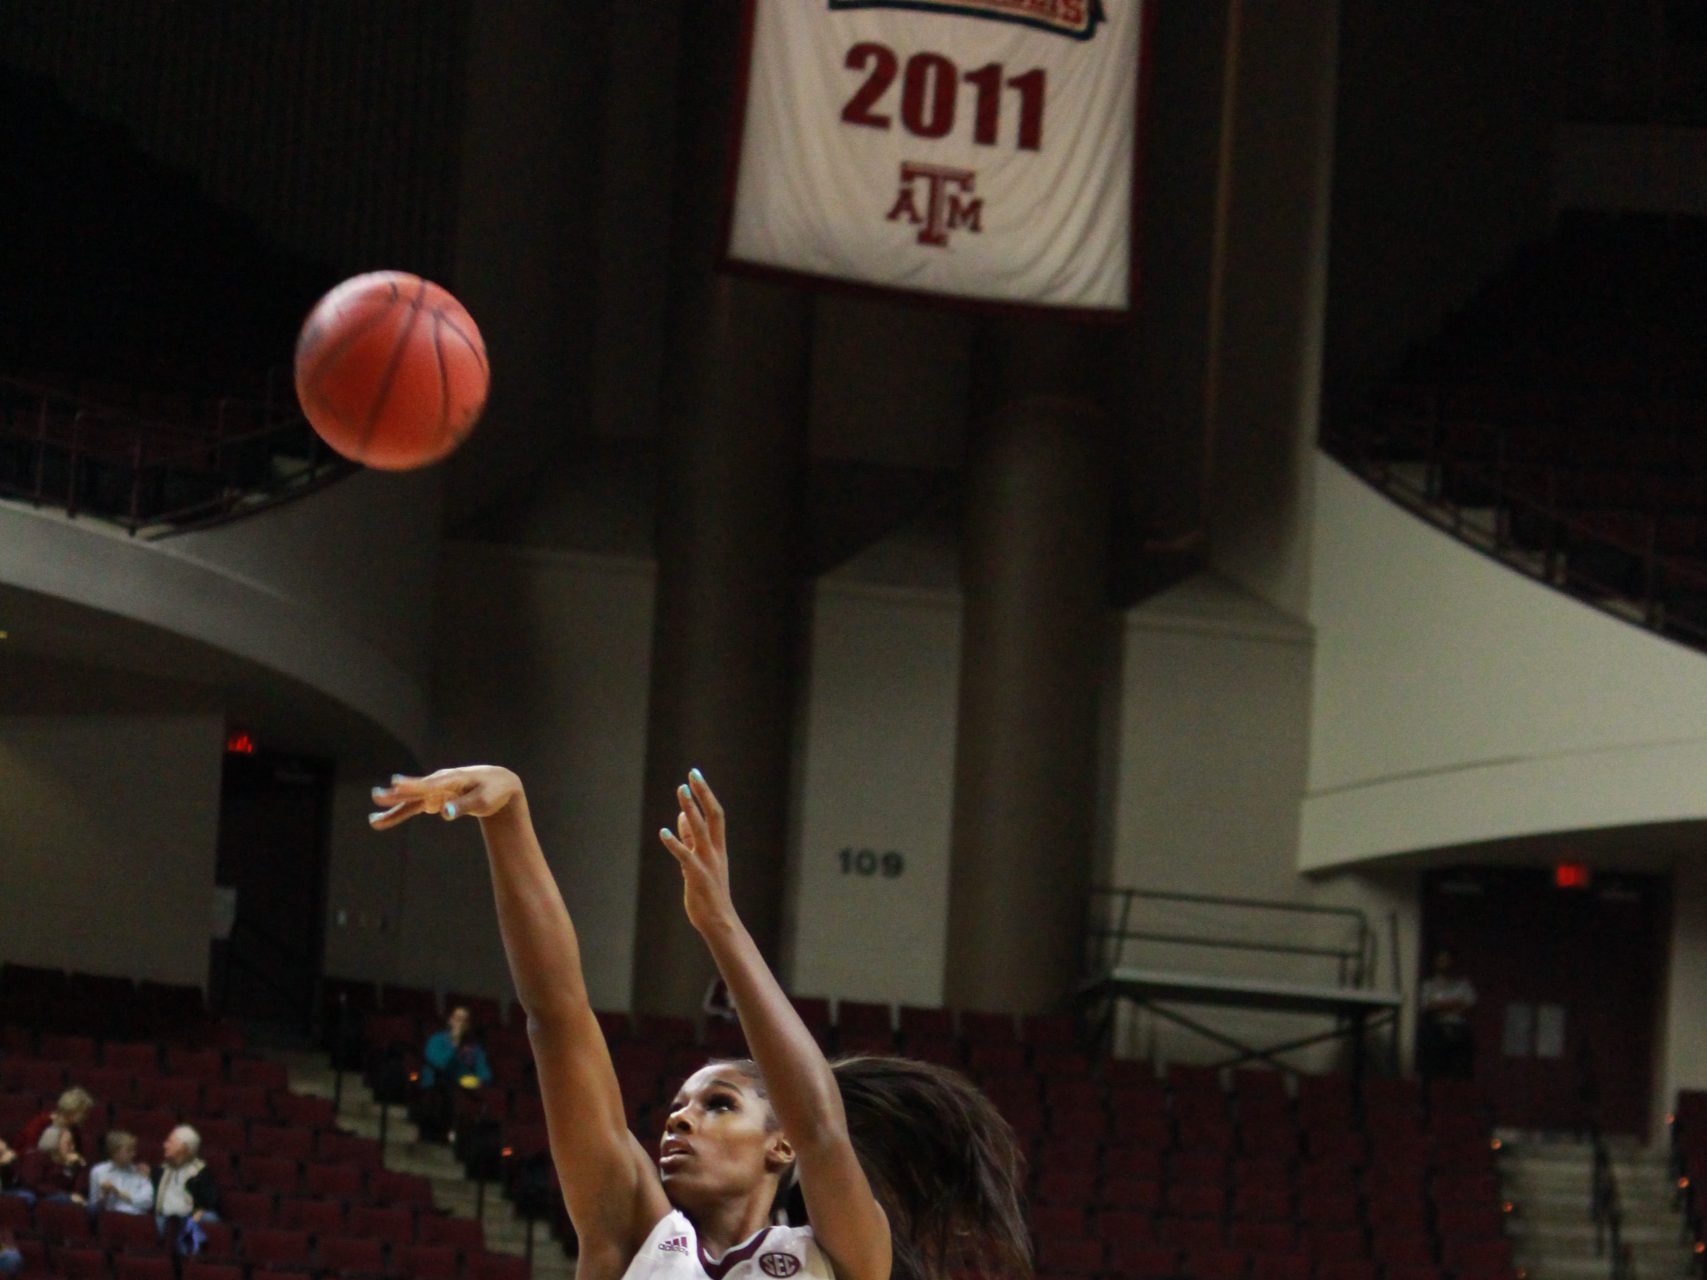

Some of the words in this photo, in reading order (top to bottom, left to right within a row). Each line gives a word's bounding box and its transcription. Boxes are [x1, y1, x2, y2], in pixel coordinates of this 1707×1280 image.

[840, 42, 1046, 152] 2011
[840, 848, 904, 878] 109
[761, 1254, 801, 1278] SEC
